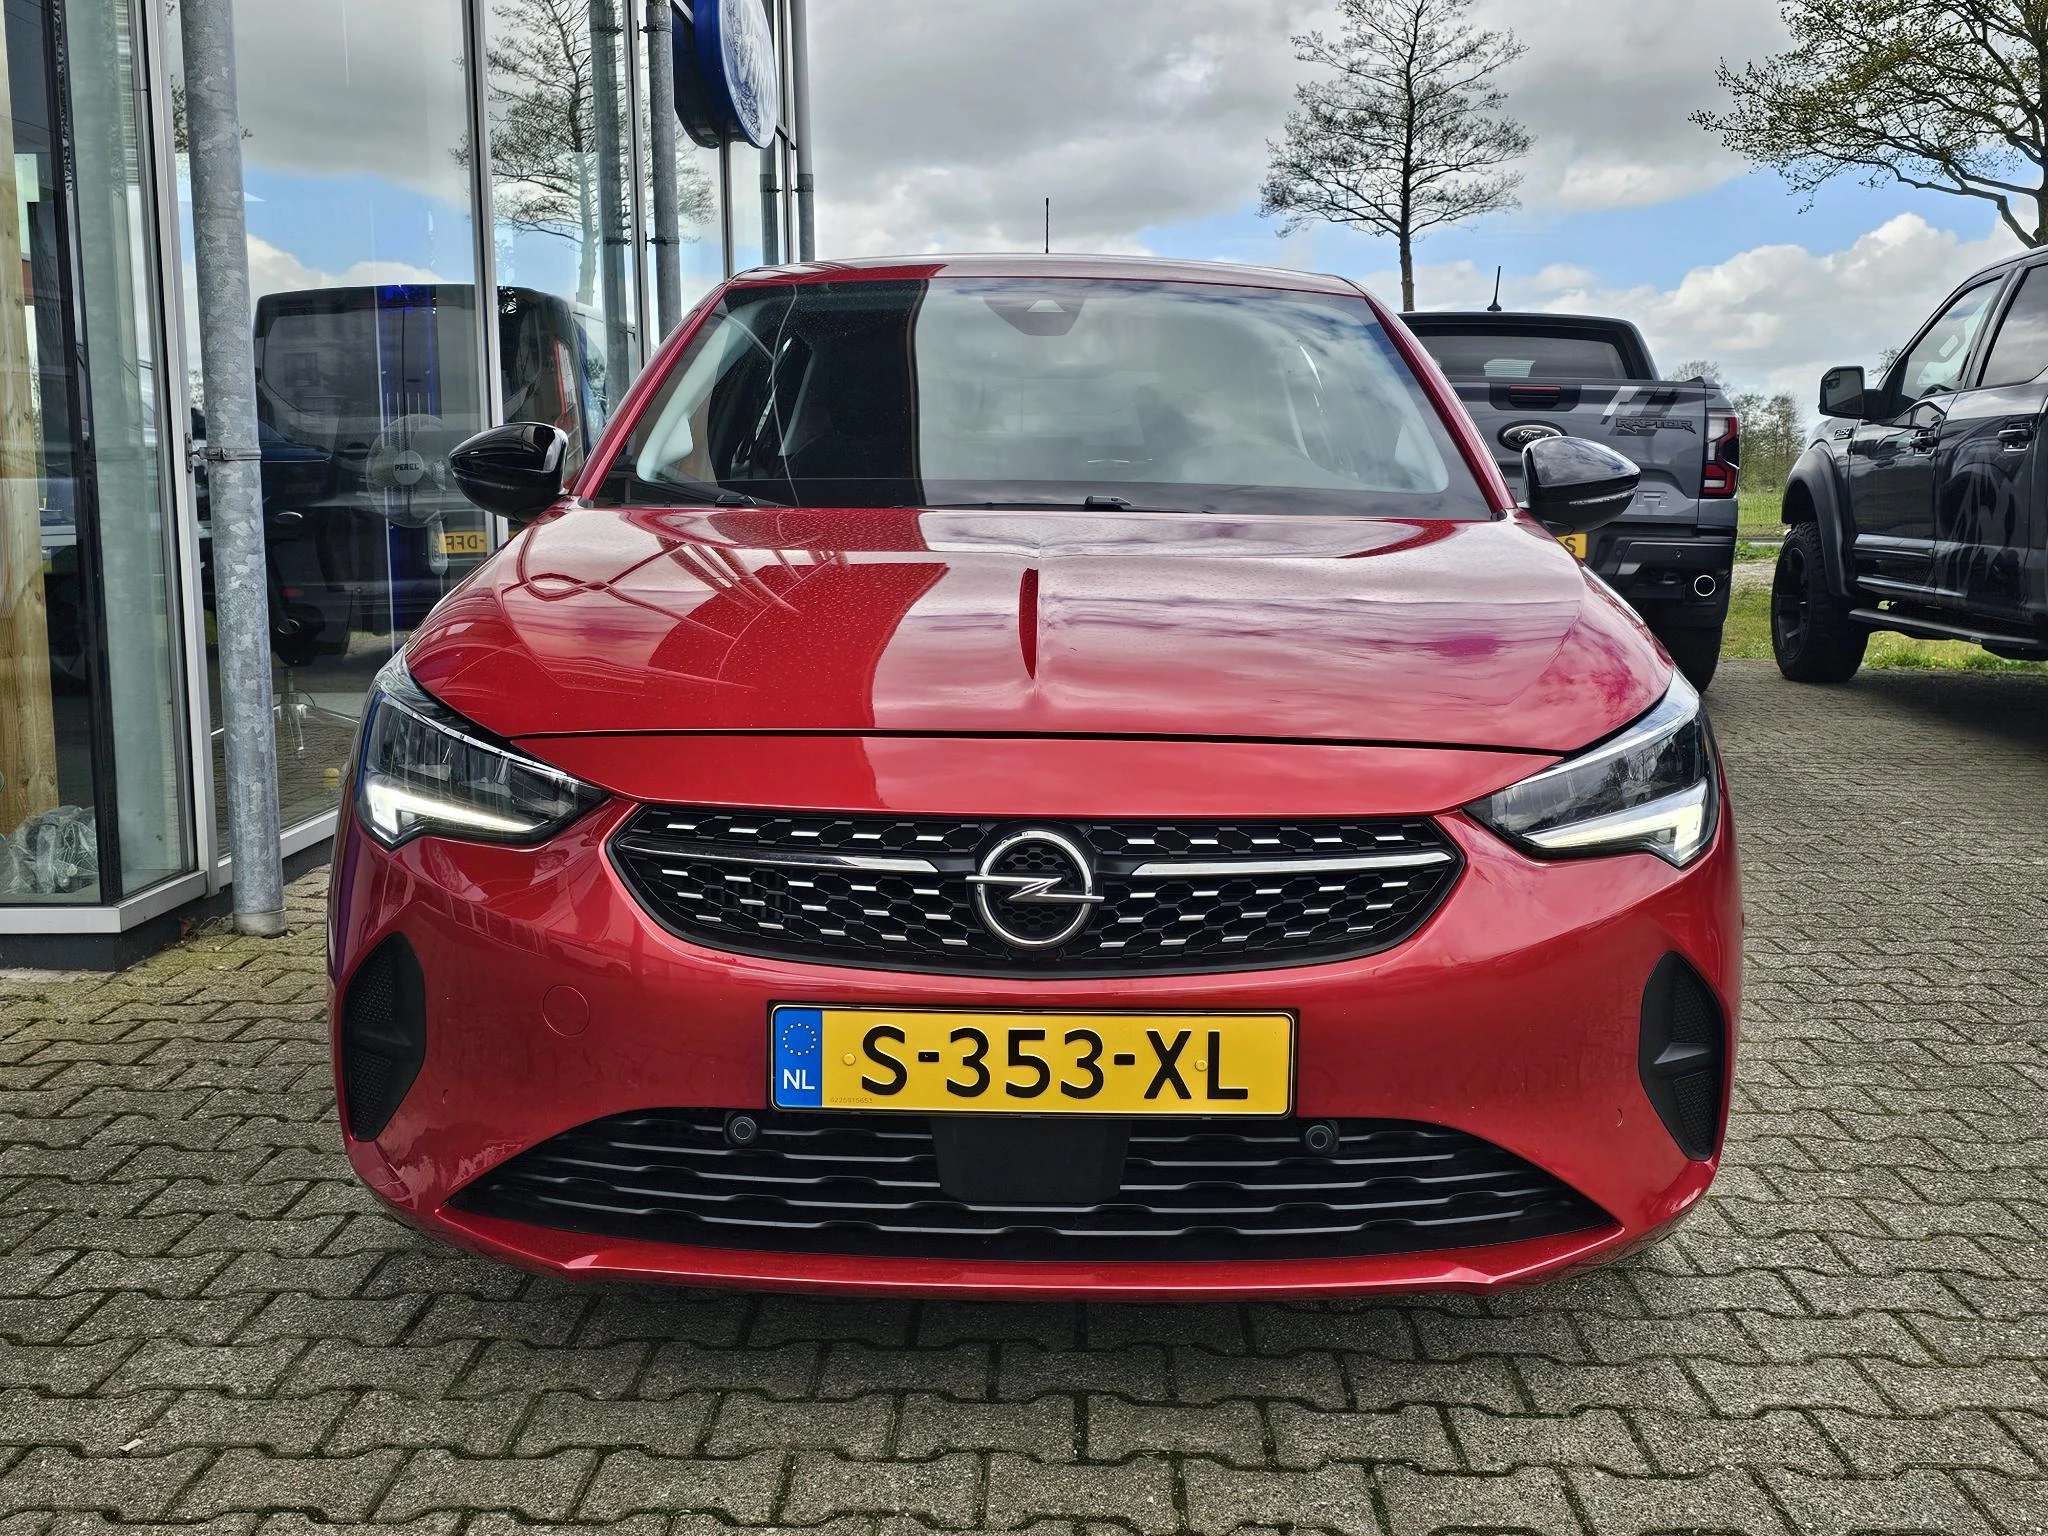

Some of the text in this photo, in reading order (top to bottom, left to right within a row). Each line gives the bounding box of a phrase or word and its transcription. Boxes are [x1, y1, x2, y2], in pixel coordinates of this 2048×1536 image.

[1616, 418, 1696, 434] RAPTOR
[395, 463, 420, 471] PEREL
[861, 1025, 1249, 1101] S-353-XL
[783, 1068, 816, 1090] NL
